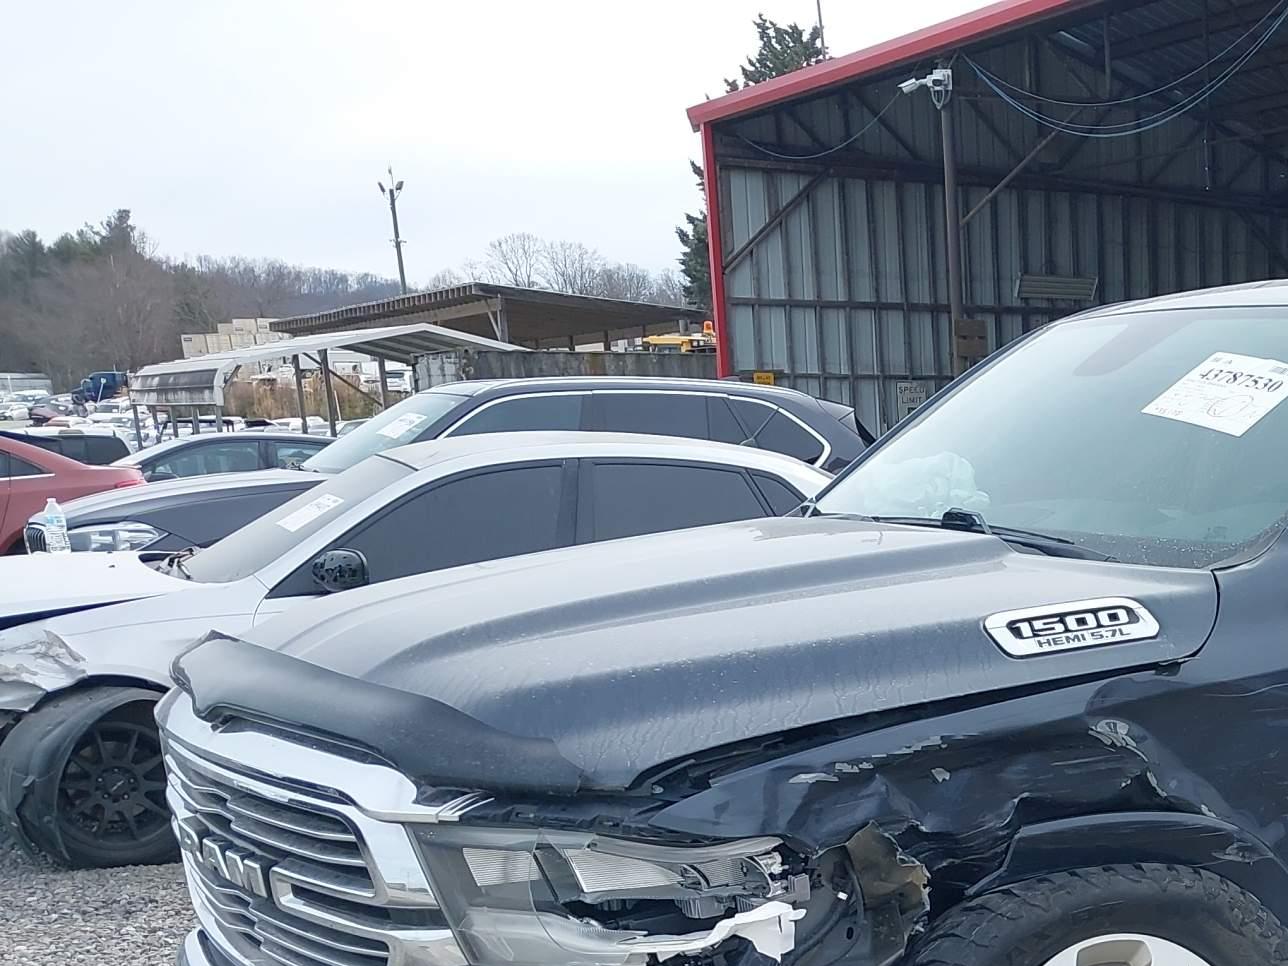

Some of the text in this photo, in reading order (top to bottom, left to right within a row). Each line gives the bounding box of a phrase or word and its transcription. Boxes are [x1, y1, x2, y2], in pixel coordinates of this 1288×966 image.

[1200, 368, 1284, 393] 43787530
[1011, 608, 1130, 640] 1500
[1035, 627, 1131, 649] HEMI 5.7L
[178, 818, 269, 898] RAM
